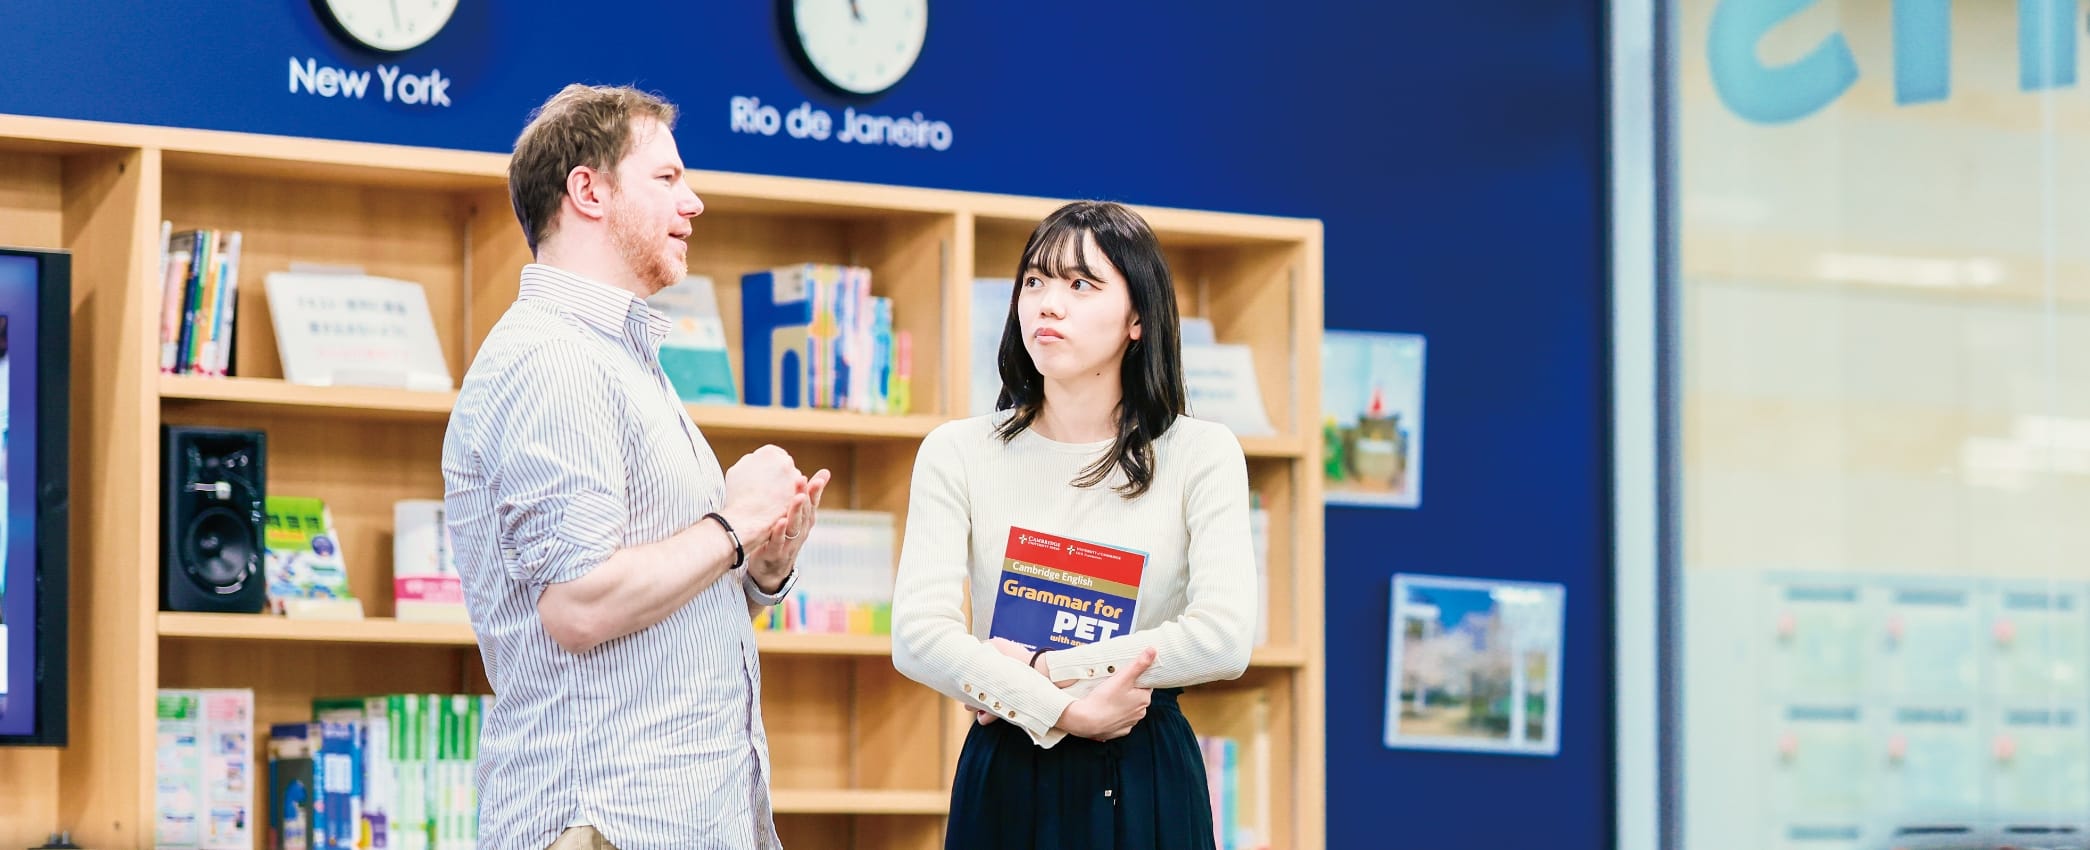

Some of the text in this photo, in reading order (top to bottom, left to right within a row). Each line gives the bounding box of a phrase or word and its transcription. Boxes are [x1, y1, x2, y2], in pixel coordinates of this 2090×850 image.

[289, 56, 452, 107] New York
[730, 96, 953, 151] Rio de Janeiro
[1028, 535, 1061, 547] CAMBRIDGE
[1012, 561, 1093, 587] Cambridge English
[1003, 579, 1123, 619] Grammar for
[1050, 635, 1070, 646] with
[1052, 611, 1120, 641] PET
